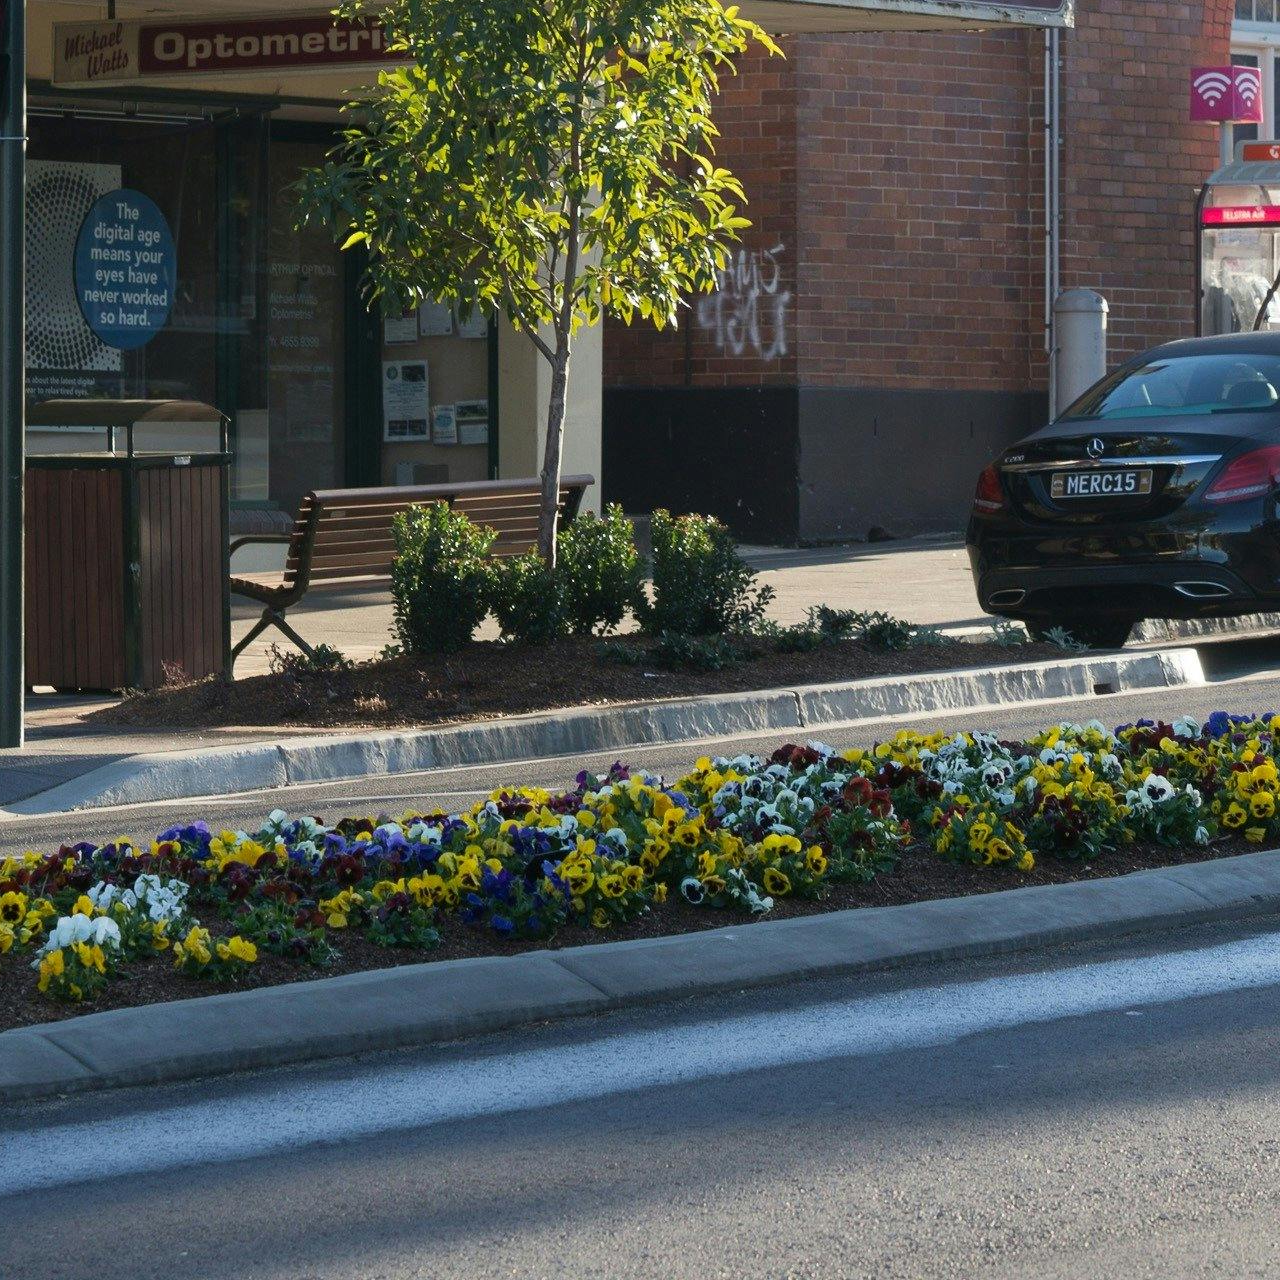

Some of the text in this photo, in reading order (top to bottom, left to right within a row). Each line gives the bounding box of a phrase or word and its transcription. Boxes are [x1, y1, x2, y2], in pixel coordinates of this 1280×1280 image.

[64, 22, 123, 60] Michael
[153, 21, 386, 67] Optometri
[87, 48, 129, 79] Watts
[117, 202, 139, 220] The
[94, 222, 161, 247] digital age
[90, 247, 163, 267] means your
[95, 269, 158, 286] eyes have
[84, 289, 167, 307] never worked
[100, 310, 151, 326] so hard.
[1066, 473, 1137, 495] MERC15
